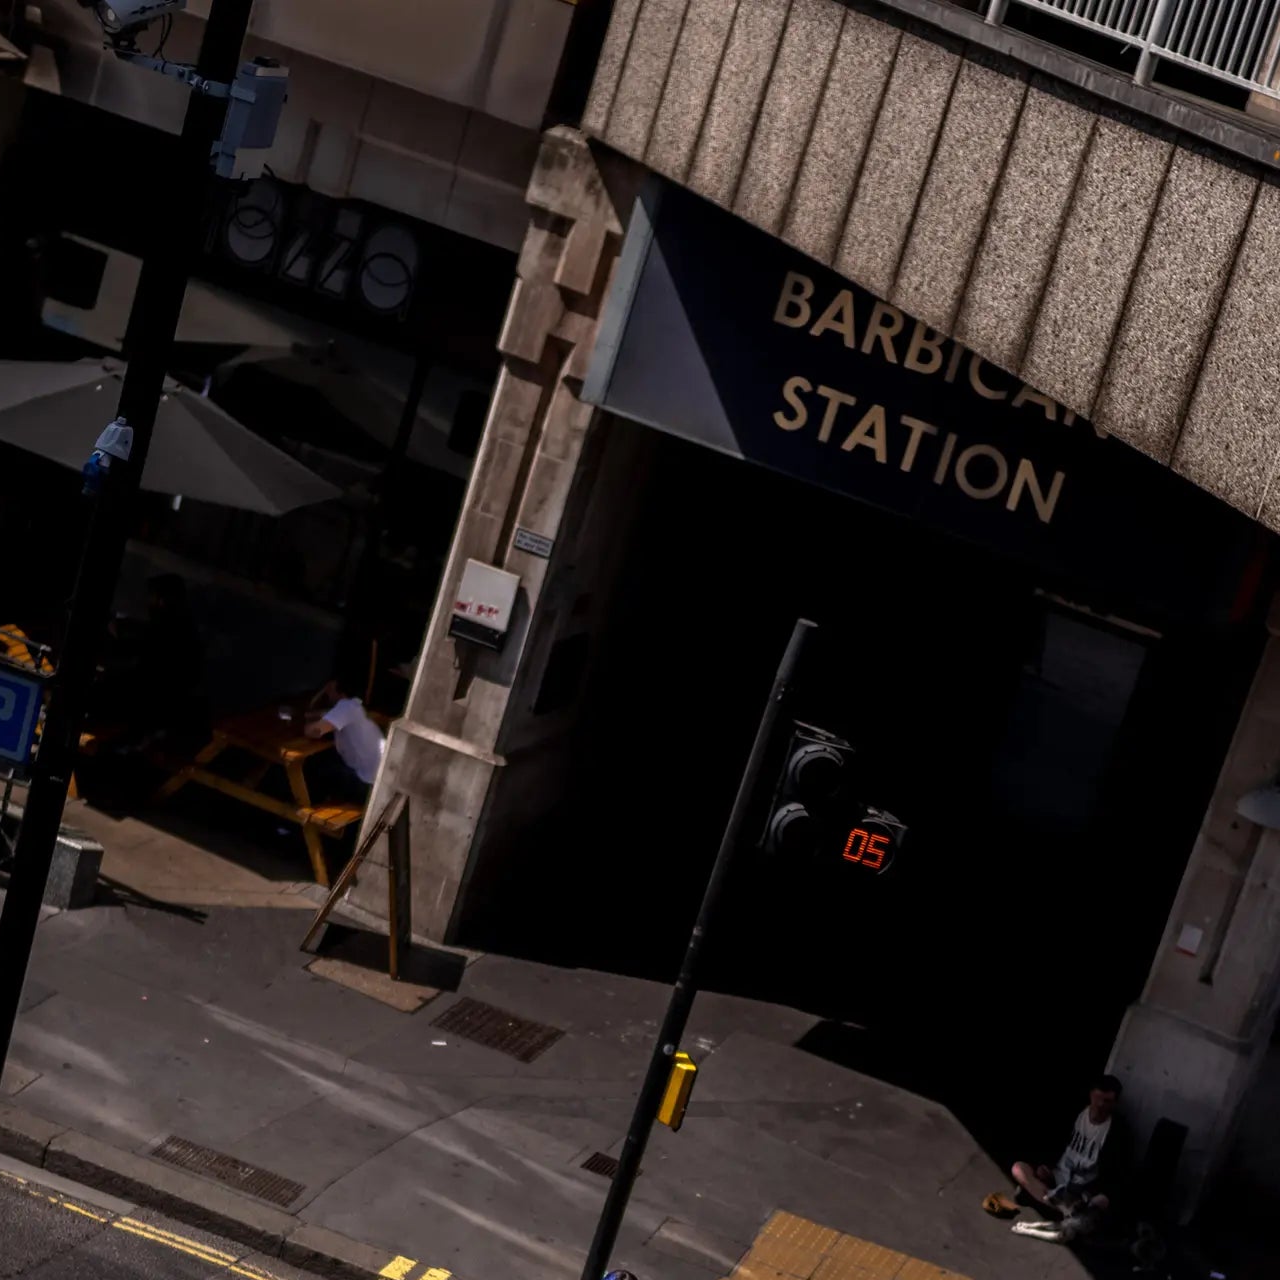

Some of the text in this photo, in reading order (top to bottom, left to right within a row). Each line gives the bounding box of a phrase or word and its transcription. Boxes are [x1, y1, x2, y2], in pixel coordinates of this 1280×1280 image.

[772, 268, 1108, 440] BARBICA
[772, 375, 1067, 525] STATION
[841, 827, 891, 870] 05
